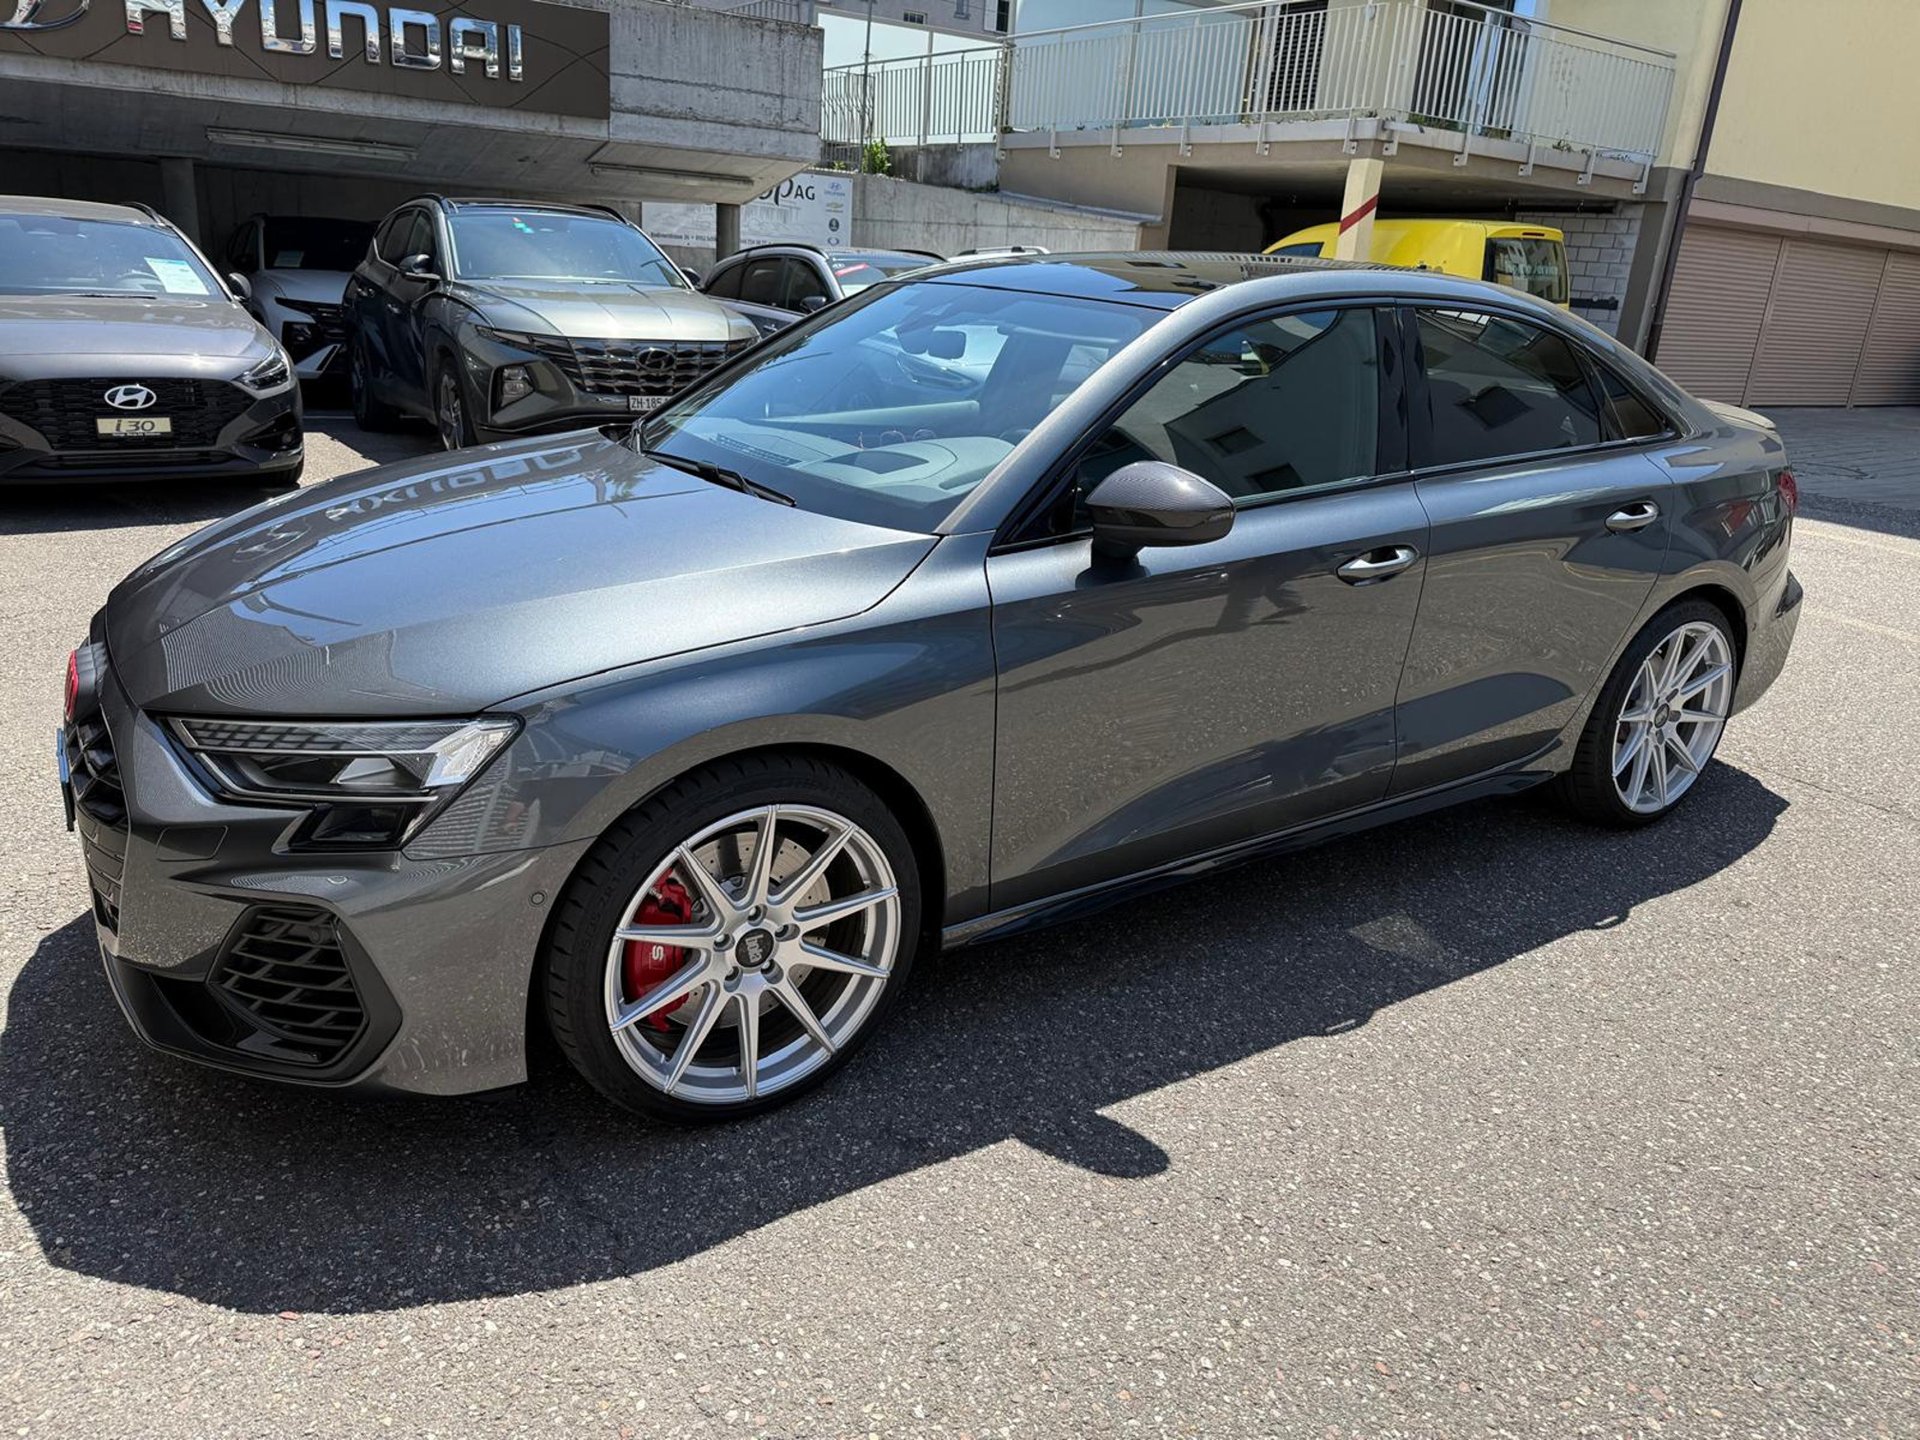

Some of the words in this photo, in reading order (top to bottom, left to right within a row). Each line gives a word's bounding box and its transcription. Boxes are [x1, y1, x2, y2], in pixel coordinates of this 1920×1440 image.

[125, 0, 524, 82] HYUNDAI
[794, 185, 815, 200] AG
[652, 945, 664, 961] S
